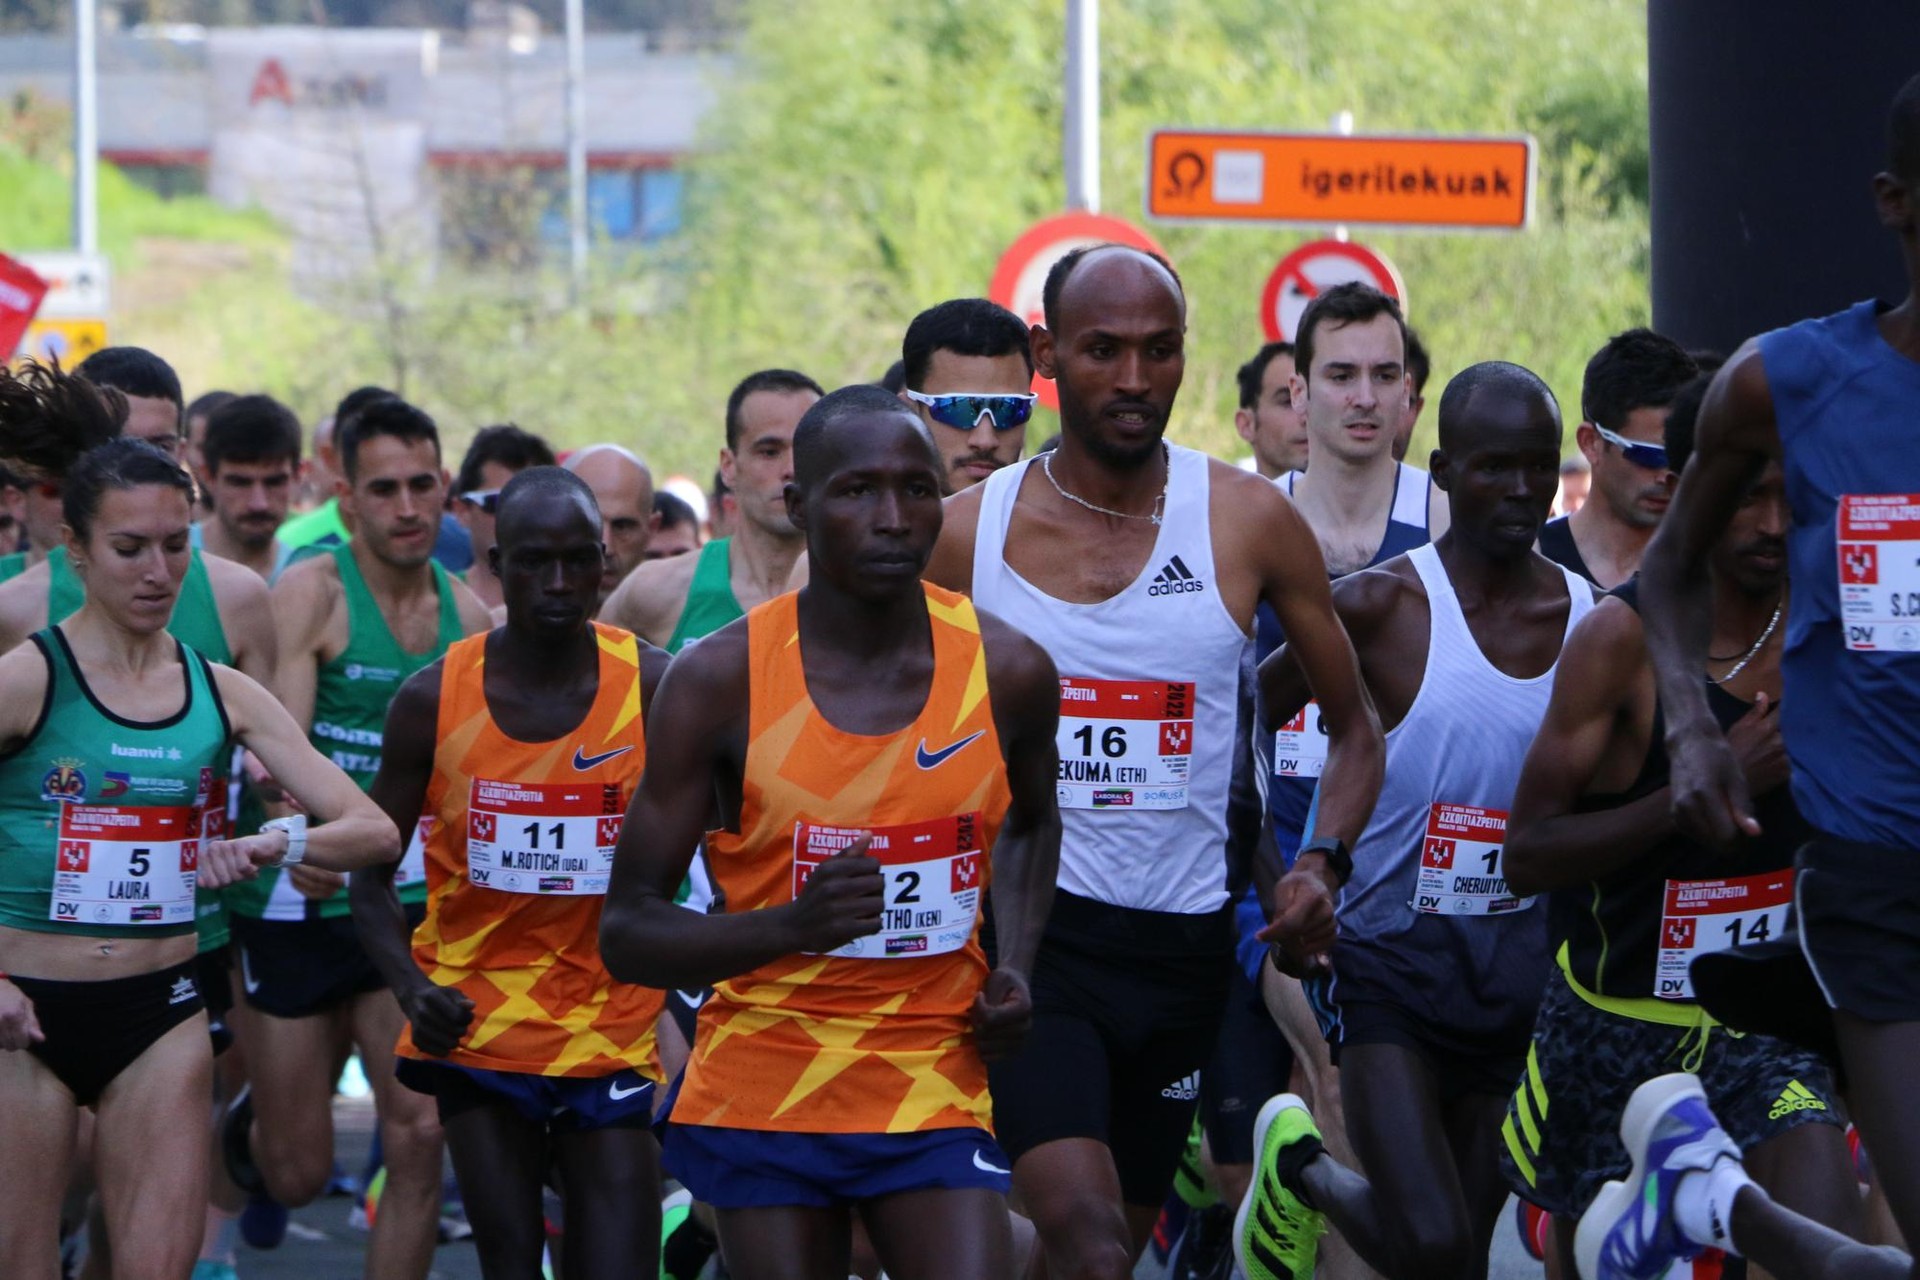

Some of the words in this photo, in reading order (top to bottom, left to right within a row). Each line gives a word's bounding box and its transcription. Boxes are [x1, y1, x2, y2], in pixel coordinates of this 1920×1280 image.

[1300, 160, 1512, 198] igerilekuak
[1148, 579, 1204, 596] adidas
[110, 742, 163, 759] luanvi
[1074, 724, 1127, 758] 16
[1058, 760, 1112, 783] EKUMA
[1116, 767, 1147, 783] (ETH)
[1280, 759, 1299, 771] DV
[1438, 810, 1507, 831] AZKOITIAZPEITIA
[523, 822, 565, 849] 11
[128, 848, 150, 877] 5
[501, 850, 560, 871] M.ROTICH
[472, 869, 490, 882] DV
[108, 881, 150, 900] LAURA
[57, 902, 80, 915] DV
[1419, 896, 1441, 908] DV
[1724, 913, 1770, 947] 14
[1661, 979, 1684, 993] DV
[1767, 1099, 1827, 1120] adidas
